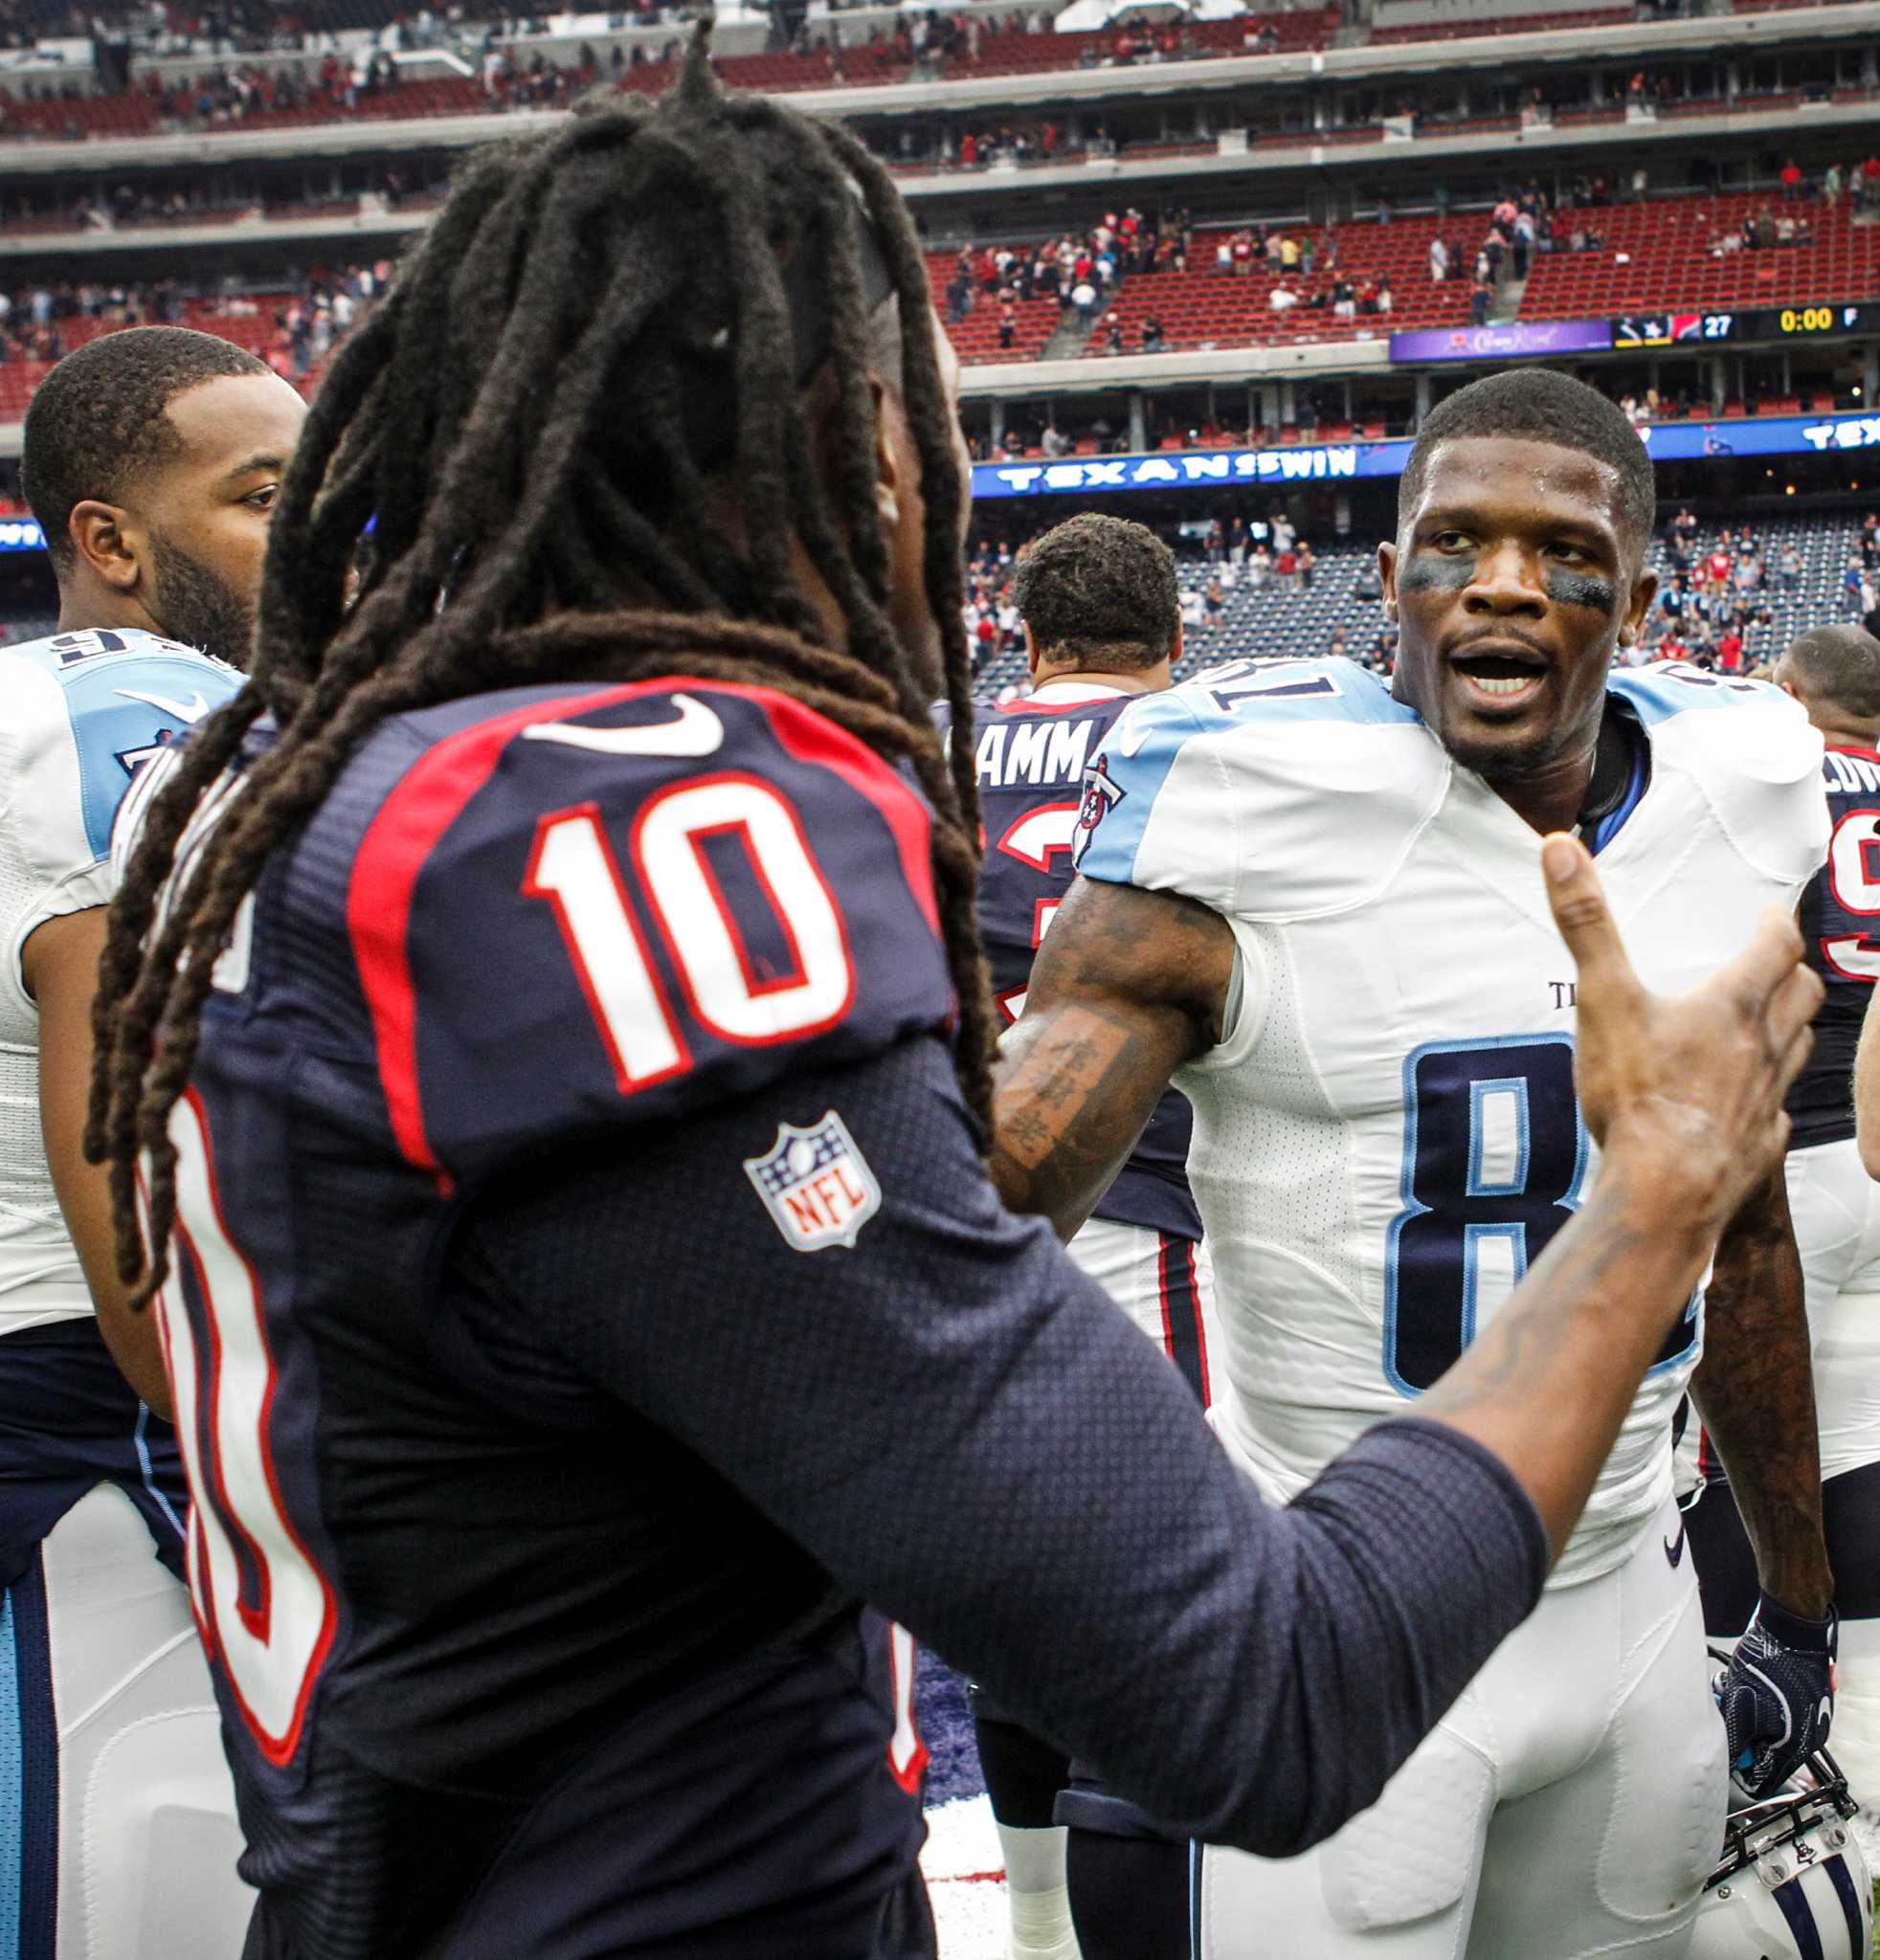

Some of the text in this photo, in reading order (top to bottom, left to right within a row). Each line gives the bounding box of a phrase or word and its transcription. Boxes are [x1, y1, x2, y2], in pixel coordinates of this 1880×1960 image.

[1705, 315, 1732, 337] 27
[1780, 307, 1832, 332] 0:00
[1279, 449, 1356, 478] WIN
[974, 719, 1094, 787] AMM
[518, 770, 857, 1096] 10
[784, 1168, 866, 1234] NFL
[1383, 1030, 1702, 1402] 8
